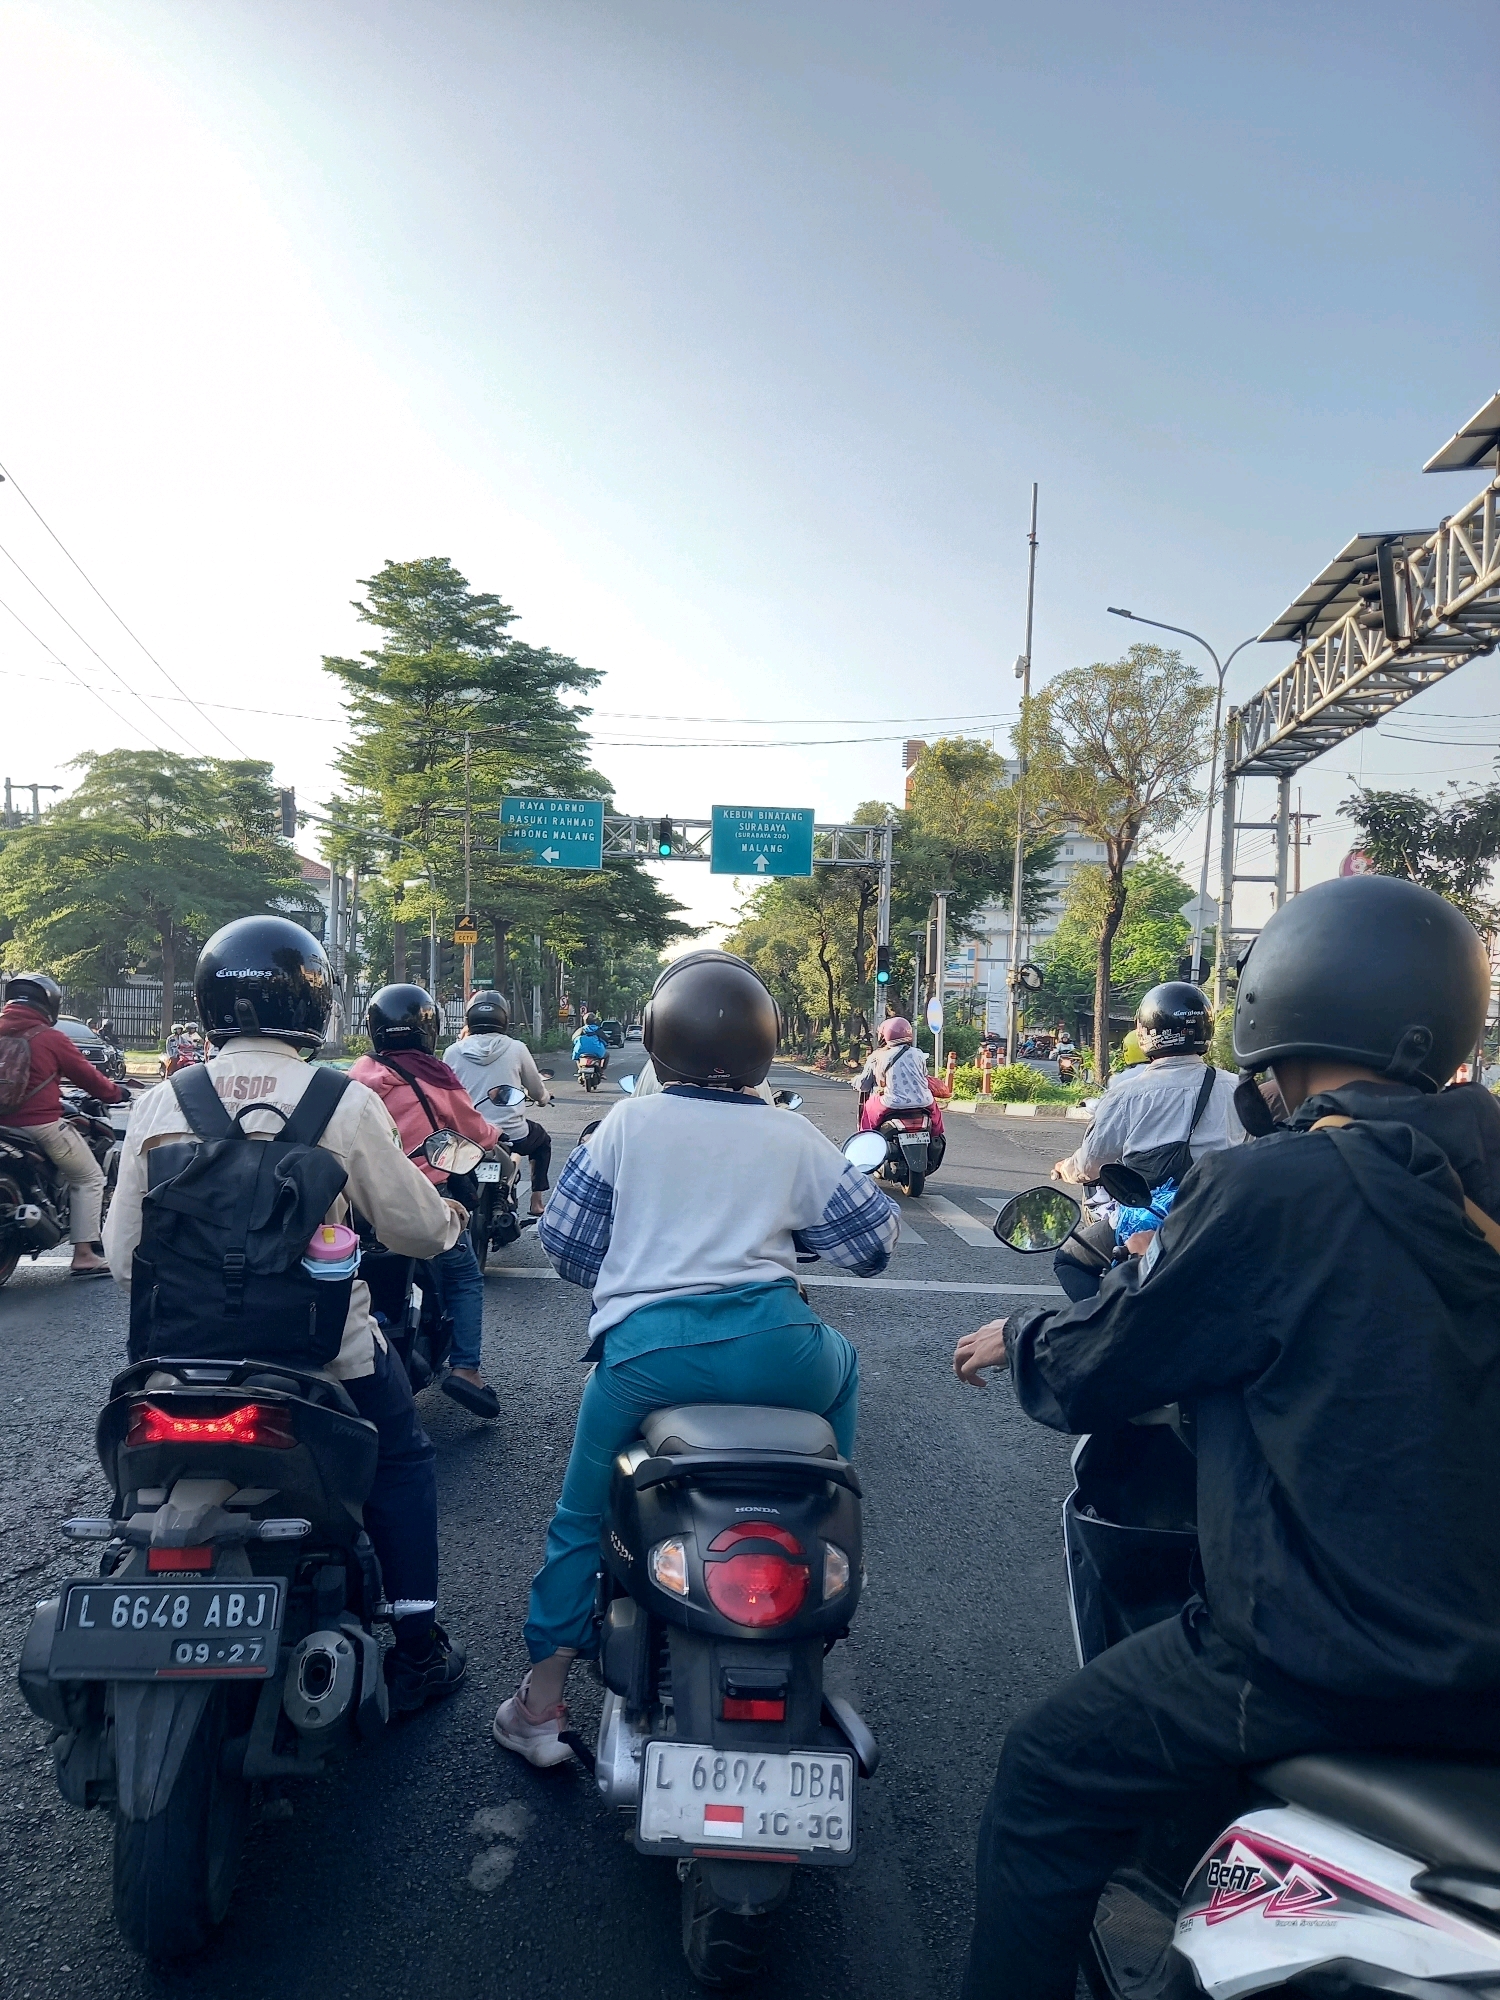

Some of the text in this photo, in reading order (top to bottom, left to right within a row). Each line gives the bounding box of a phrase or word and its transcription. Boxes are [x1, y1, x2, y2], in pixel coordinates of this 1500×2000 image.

[519, 801, 585, 813] RAYA DARMO
[509, 814, 594, 827] BASUKI RAHMAD
[723, 810, 803, 821] KEBUN BINATANG
[739, 822, 786, 832] SURABAYA
[553, 831, 595, 841] MALANG
[741, 843, 782, 853] MALANG
[215, 967, 273, 979] Cargloss
[734, 1506, 780, 1515] HONDA
[78, 1593, 267, 1629] L 6648 ABJ
[656, 1752, 844, 1801] L 6894 DBA
